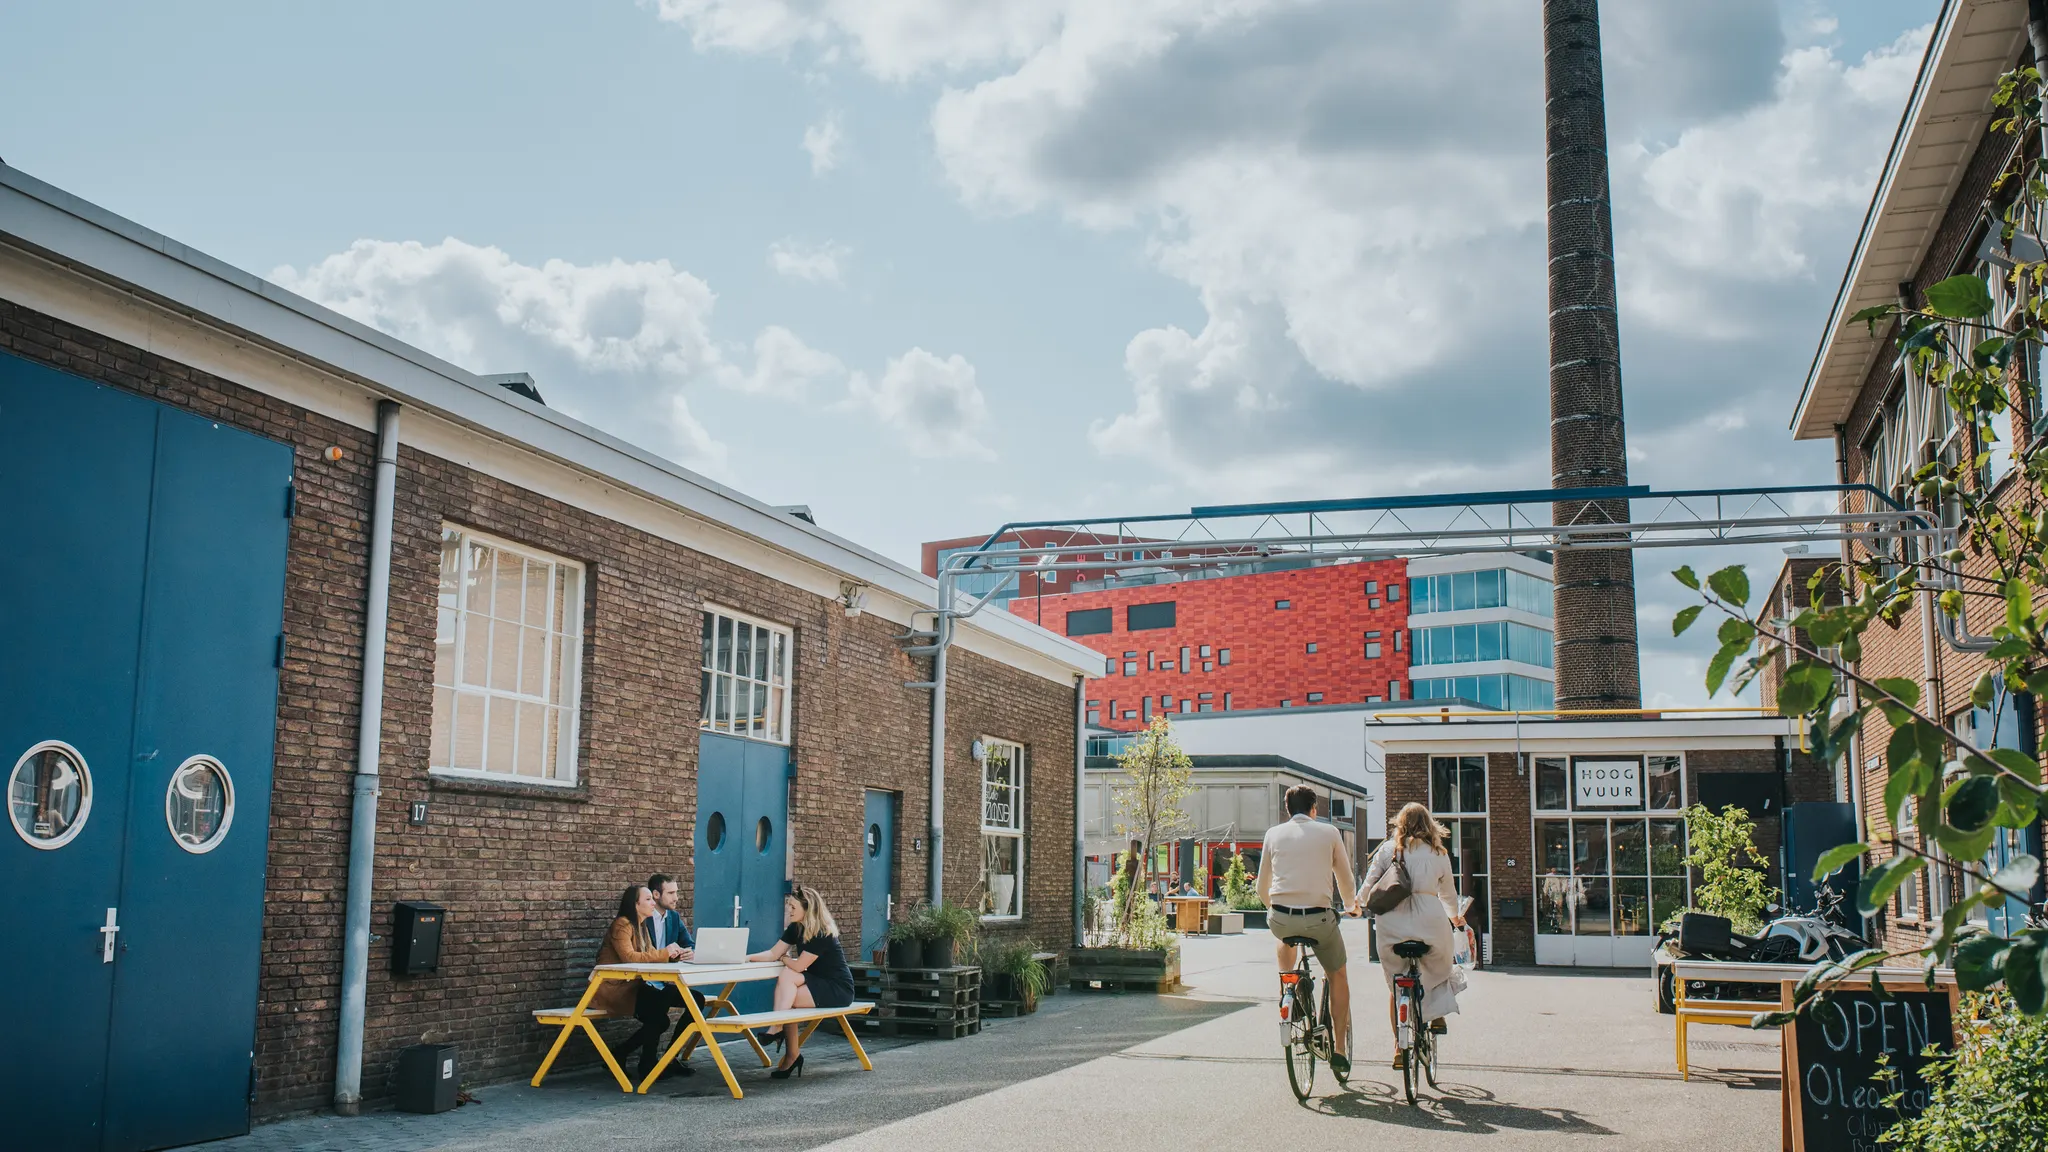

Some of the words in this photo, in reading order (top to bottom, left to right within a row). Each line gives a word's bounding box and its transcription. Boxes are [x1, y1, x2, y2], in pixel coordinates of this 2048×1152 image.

[1582, 769, 1633, 779] HOOG
[1582, 786, 1633, 797] VUUR
[414, 804, 426, 821] 17
[1823, 1001, 1929, 1056] OPEN
